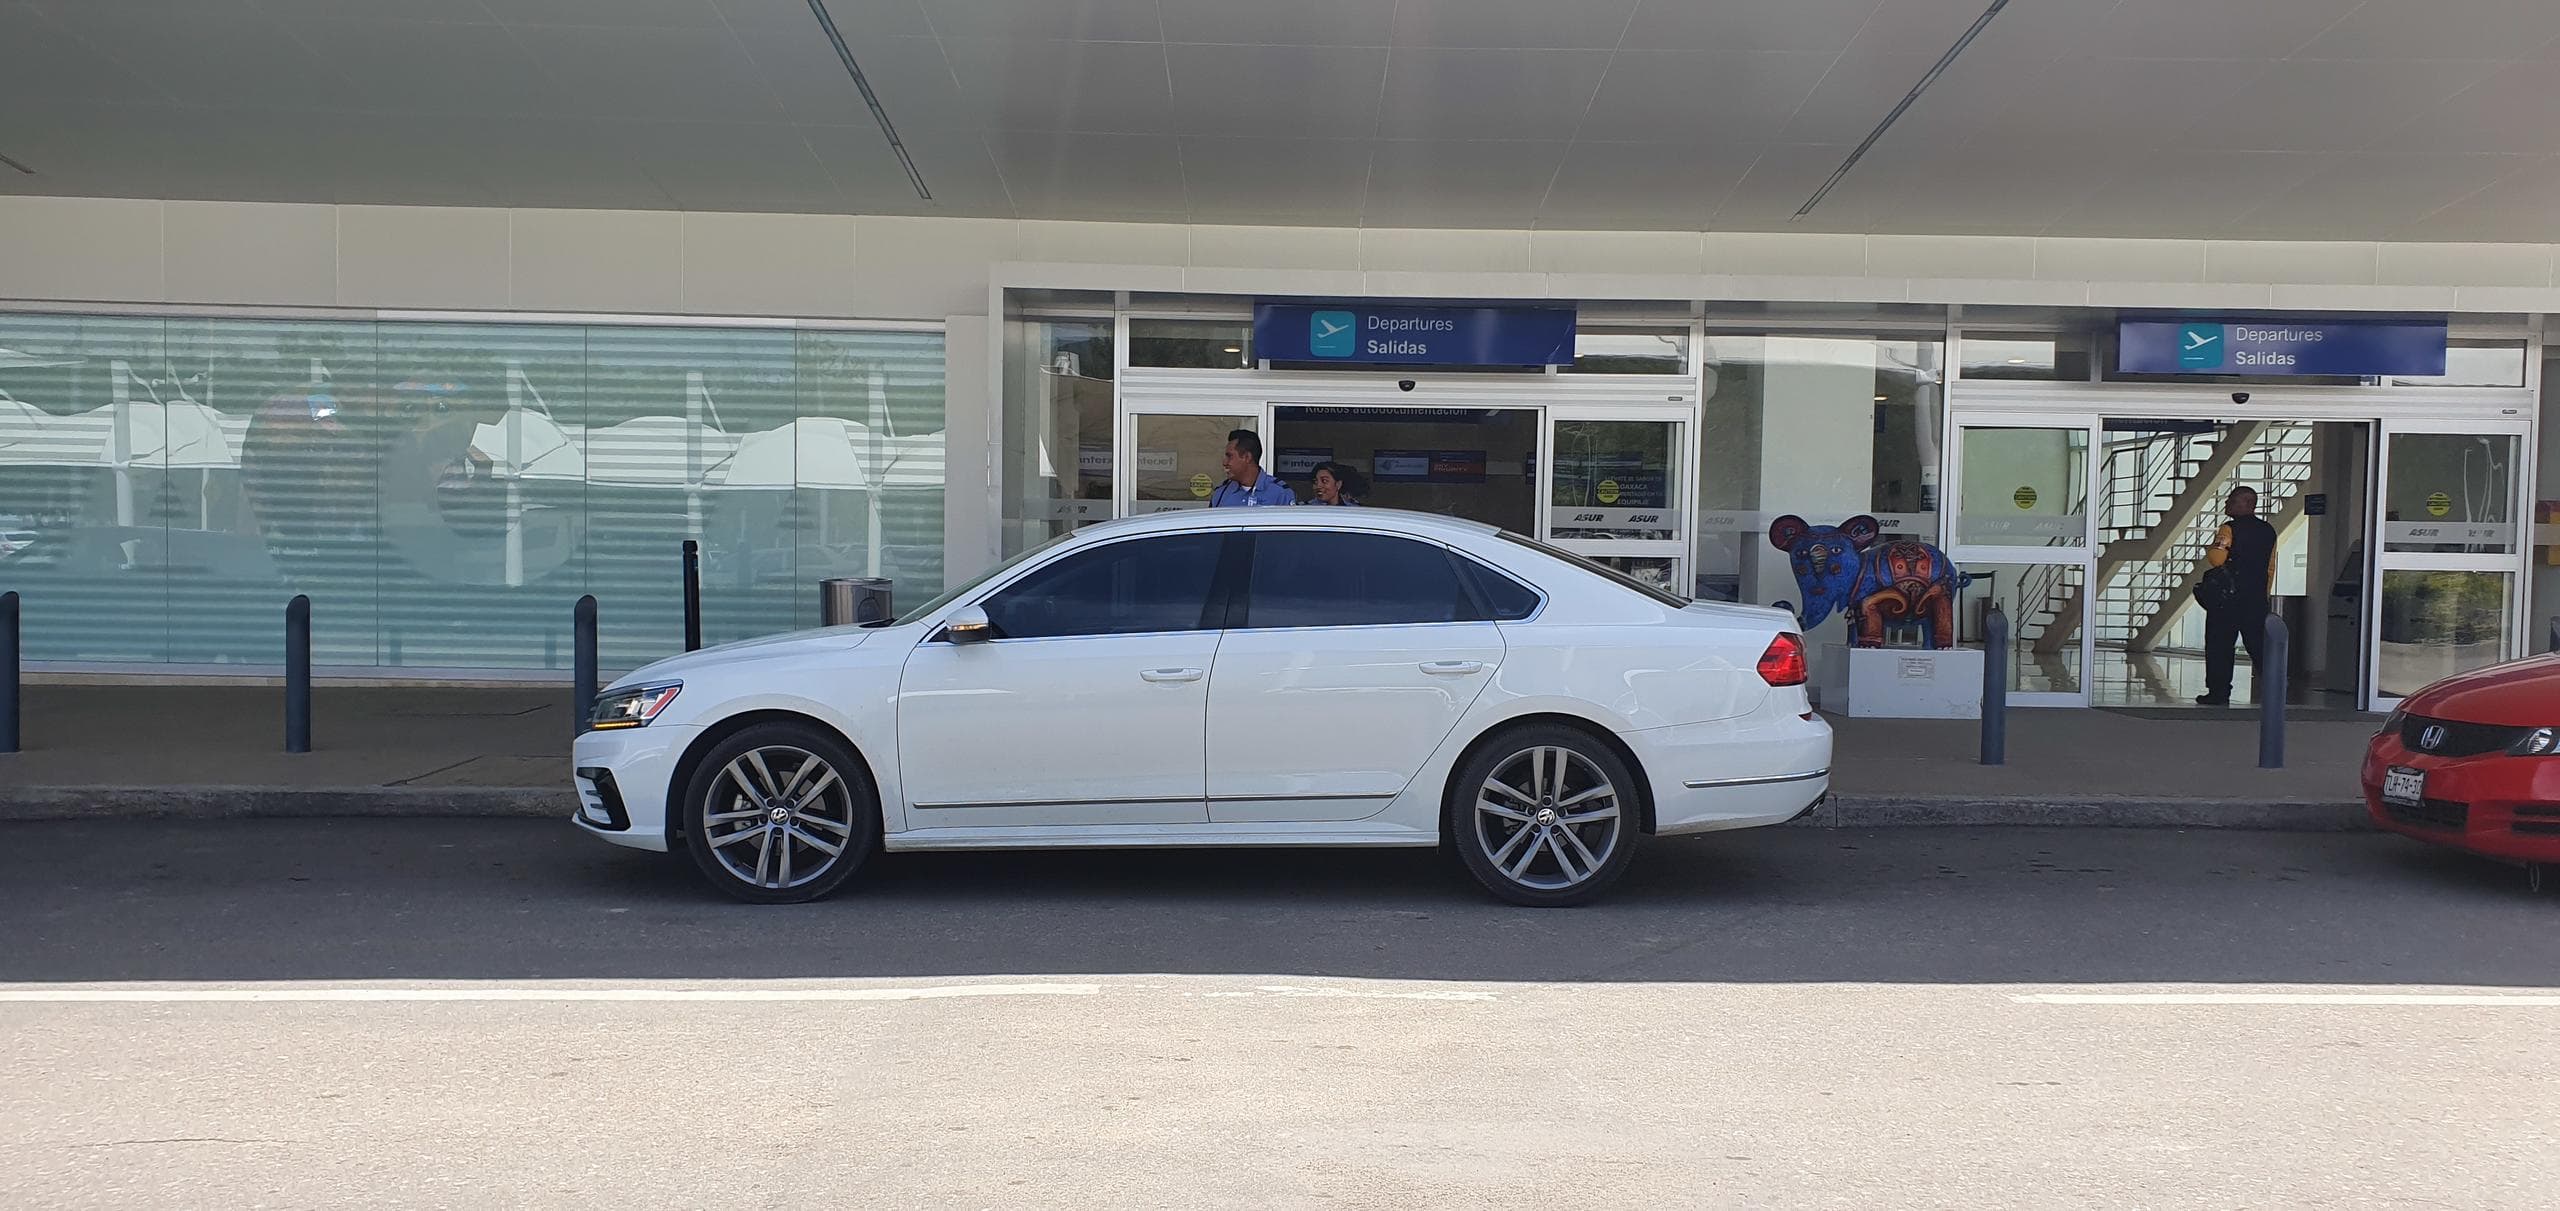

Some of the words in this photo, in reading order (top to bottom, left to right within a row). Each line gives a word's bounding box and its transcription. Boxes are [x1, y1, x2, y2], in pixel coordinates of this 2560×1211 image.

[1367, 315, 1454, 334] Departures
[2236, 327, 2323, 344] Departures
[1367, 339, 1427, 355] Salidas
[2235, 351, 2296, 365] Salidas
[1574, 513, 1605, 522] ASUR
[1628, 514, 1659, 523] ASUR
[1878, 519, 1900, 528] SUR
[2409, 528, 2439, 537] ASUR
